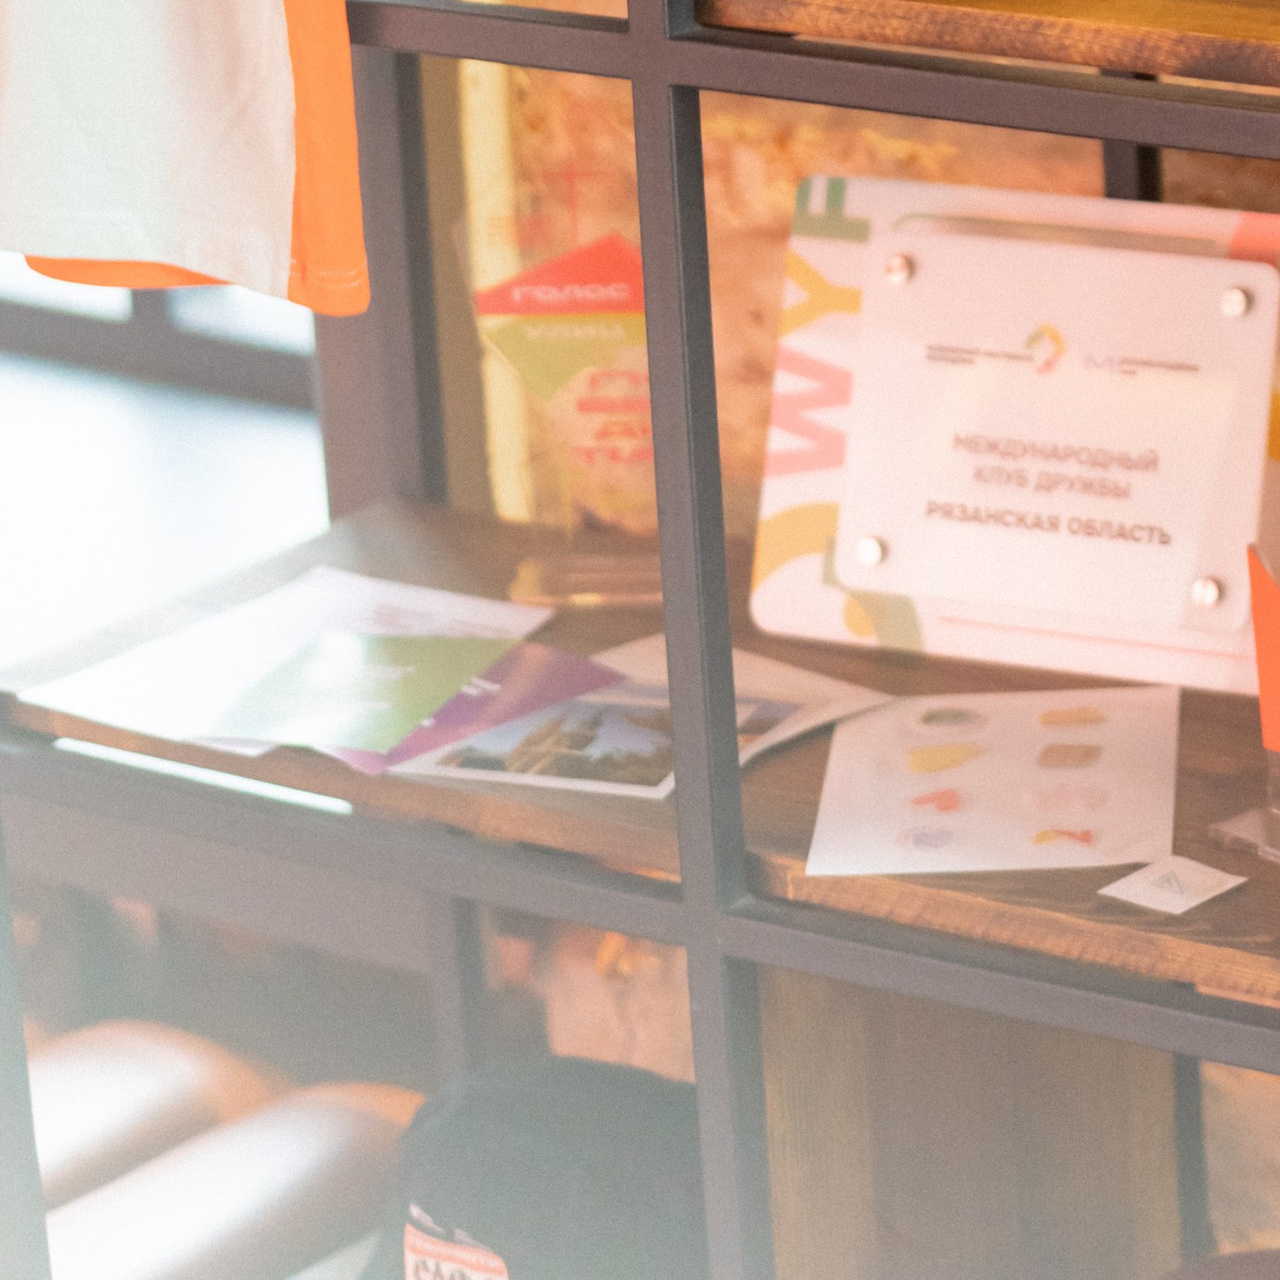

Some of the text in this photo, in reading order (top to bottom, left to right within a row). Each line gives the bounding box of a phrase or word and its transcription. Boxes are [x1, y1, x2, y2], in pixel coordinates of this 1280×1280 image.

[952, 432, 1159, 472] МЕЖДУНАРОДНЫЙ
[1034, 470, 1132, 500] ДРУЖБЫ
[925, 499, 1173, 547] РЯЗАНСКАЯ ОБЛАСТЬ
